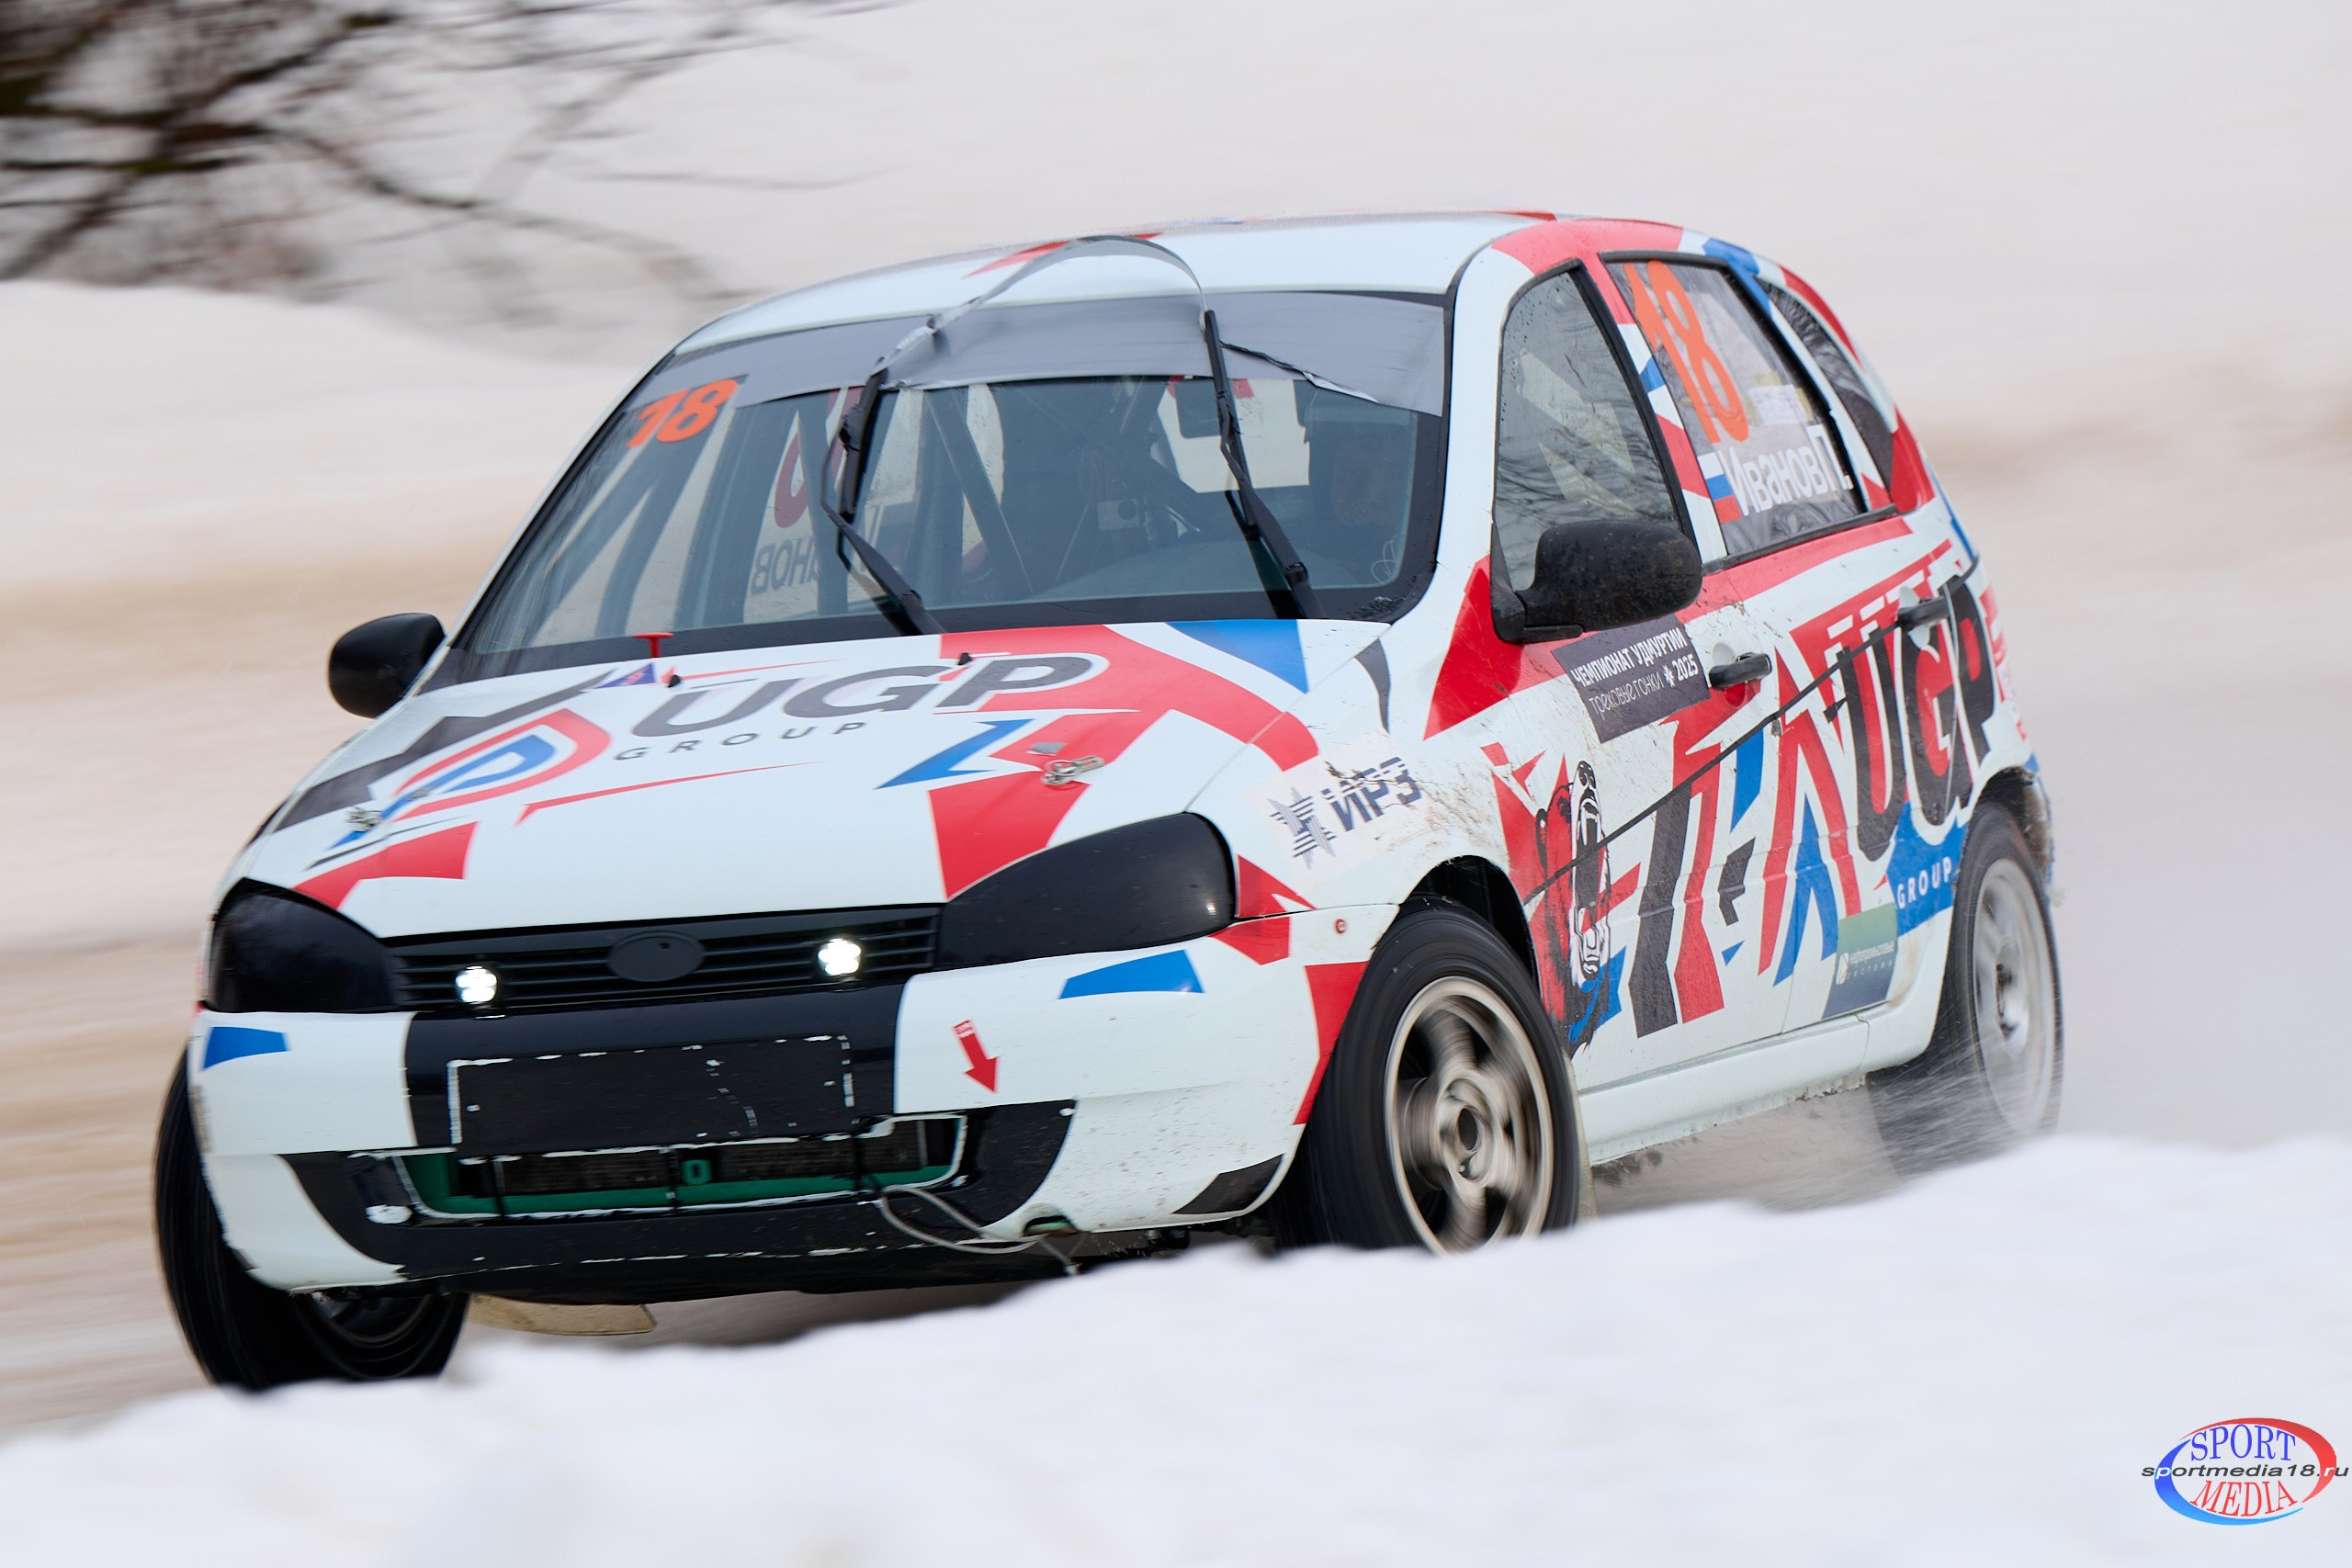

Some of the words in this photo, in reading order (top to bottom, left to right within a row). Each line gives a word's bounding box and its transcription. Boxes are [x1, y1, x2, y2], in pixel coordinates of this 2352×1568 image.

[1623, 260, 1749, 444] 18
[624, 378, 738, 448] 18
[1717, 446, 1829, 515] Иванов
[1570, 648, 1634, 687] ЧЕМПИОНАТ
[1630, 627, 1687, 667] УДМУРТИИ
[1672, 654, 1699, 681] 2025
[631, 654, 1093, 738] UGP
[1836, 575, 1996, 862] UGP
[613, 722, 866, 761] GROUP
[1897, 855, 1952, 909] GROUP
